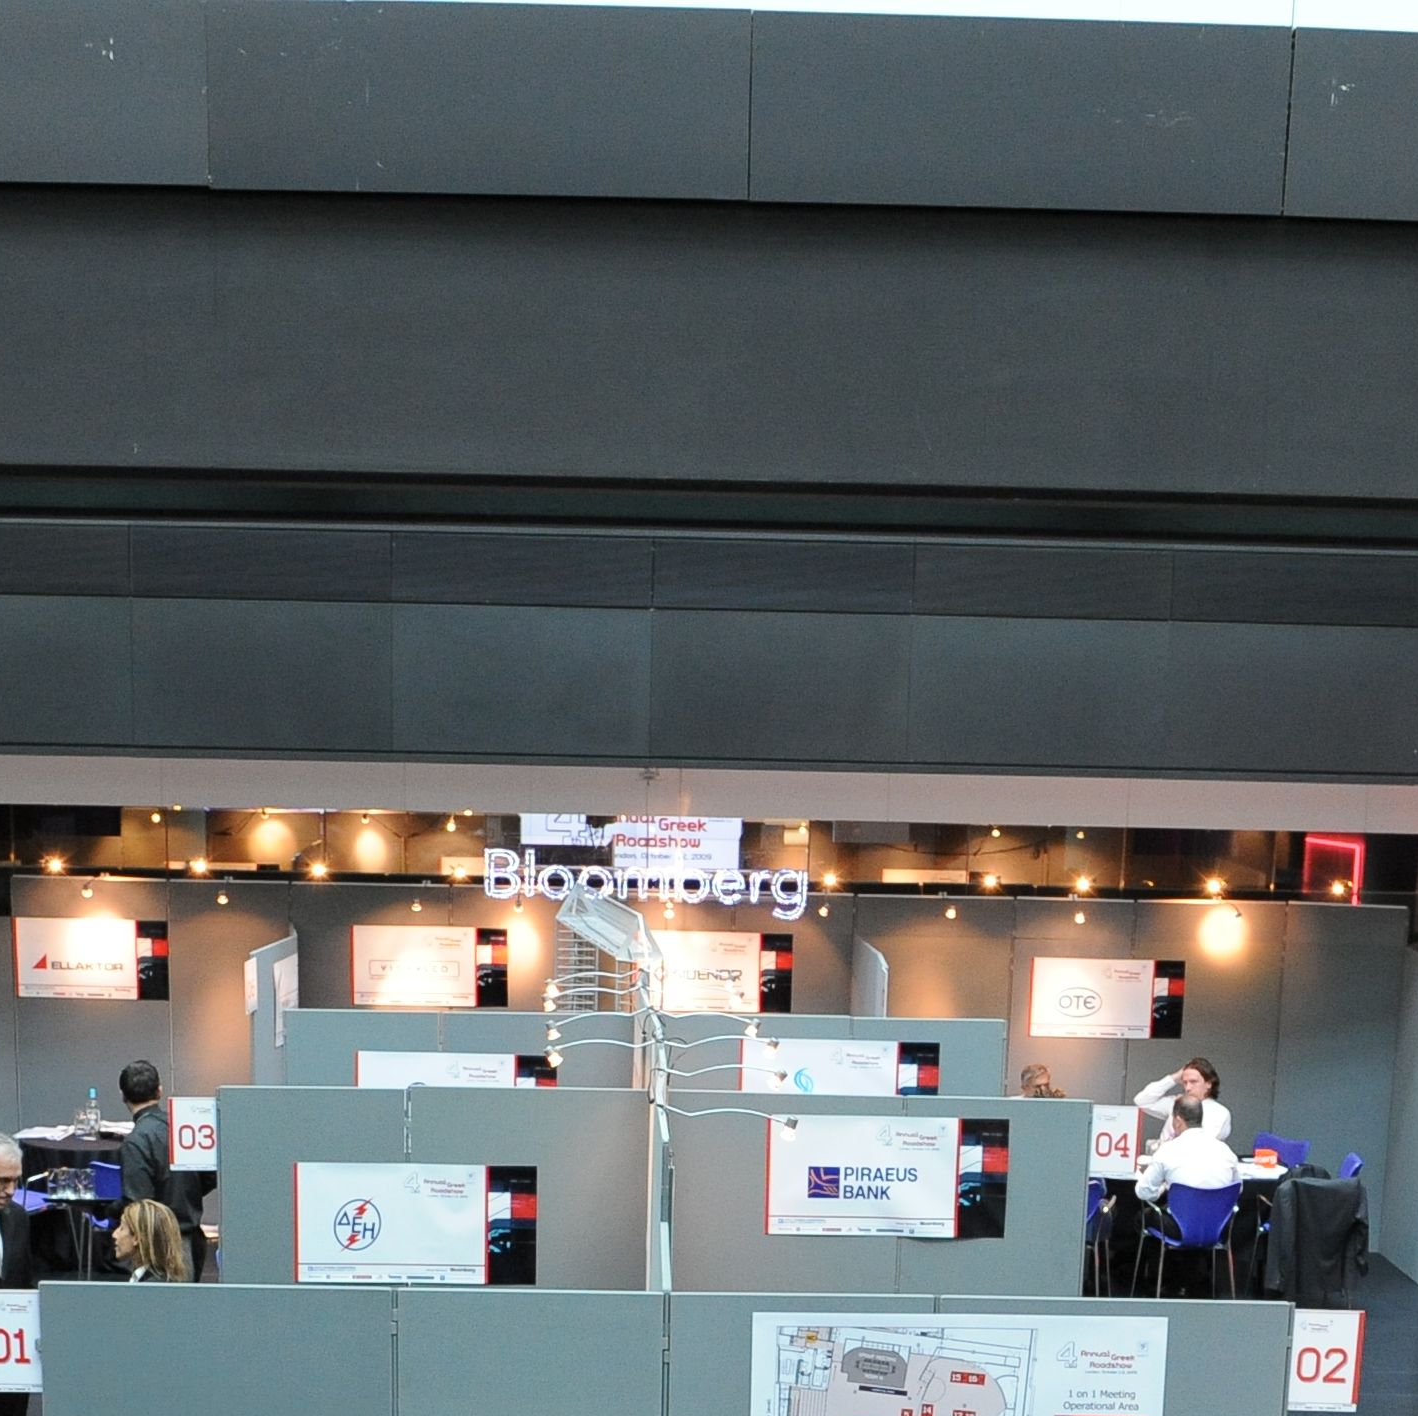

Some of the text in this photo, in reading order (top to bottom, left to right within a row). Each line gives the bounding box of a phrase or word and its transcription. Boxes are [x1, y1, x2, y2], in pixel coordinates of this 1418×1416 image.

[658, 818, 707, 832] Greek
[614, 834, 701, 848] Roadshow
[483, 847, 809, 921] Bloomberg
[178, 1124, 215, 1150] 03
[1095, 1132, 1130, 1158] 04
[843, 1166, 918, 1182] PIRAEUS
[843, 1185, 891, 1200] BANK
[1296, 1347, 1348, 1384] 02
[1068, 1389, 1073, 1398] 1
[1092, 1389, 1096, 1398] 1
[1100, 1390, 1136, 1400] Meeting
[1062, 1401, 1140, 1411] Operational Area
